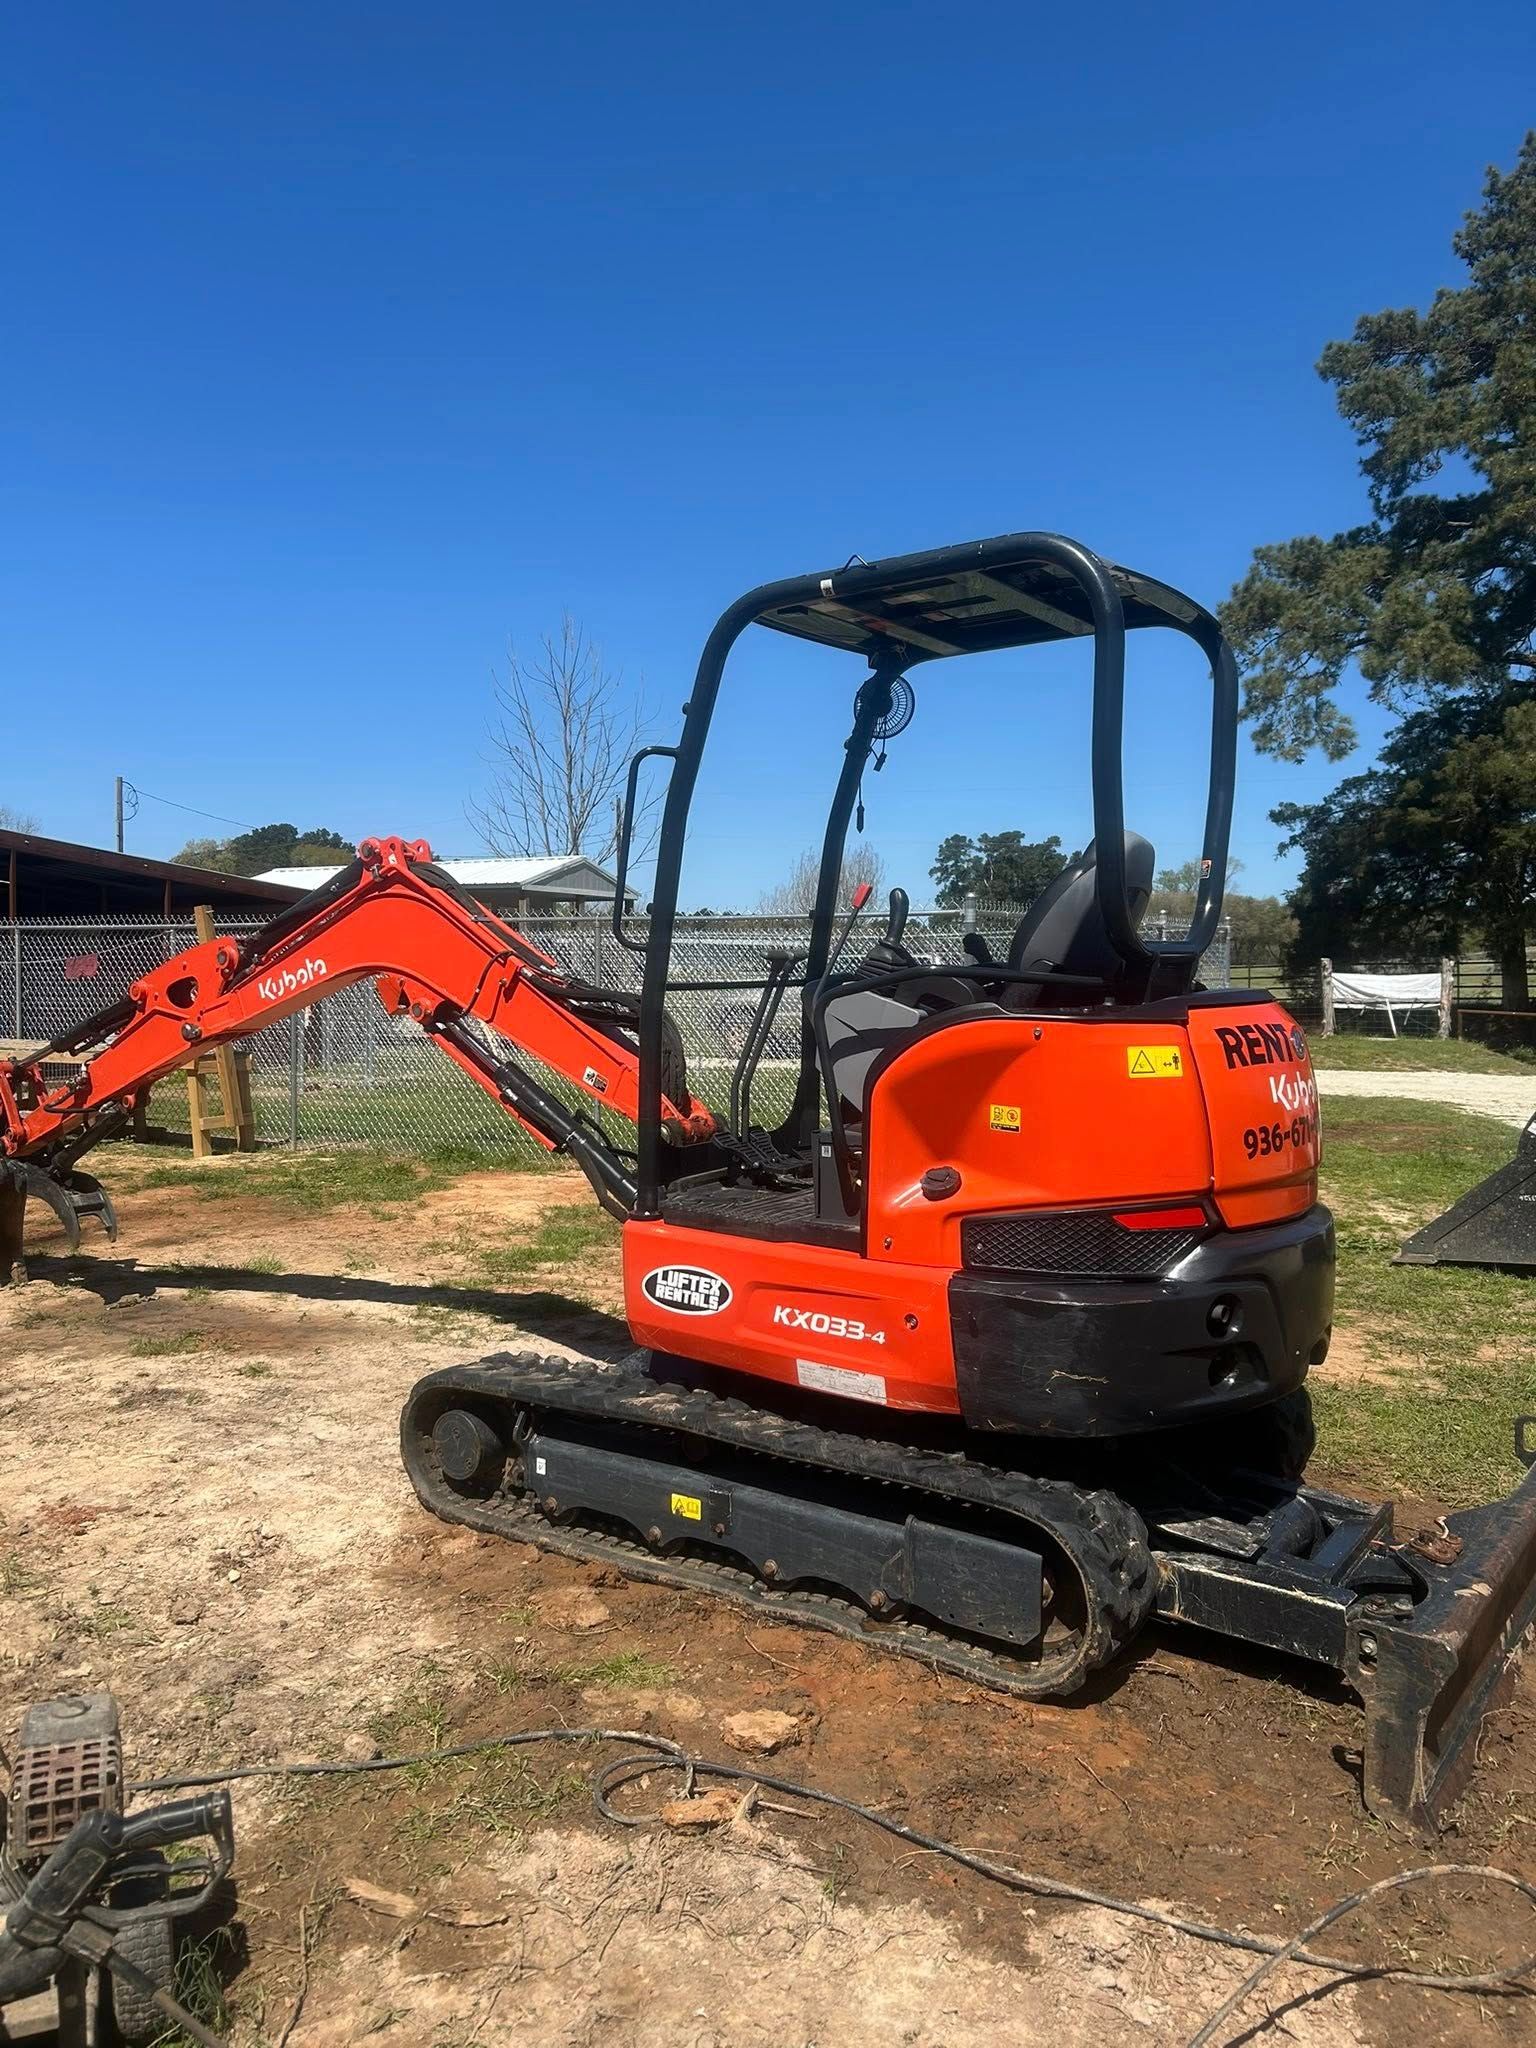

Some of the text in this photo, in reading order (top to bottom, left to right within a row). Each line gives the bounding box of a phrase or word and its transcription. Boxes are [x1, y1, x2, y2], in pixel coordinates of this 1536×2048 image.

[258, 958, 327, 1000] Kubota
[1214, 1023, 1294, 1069] RENT
[655, 1284, 719, 1310] RENTALS
[656, 1269, 721, 1296] LUFTEX
[773, 1305, 886, 1345] KX033-4
